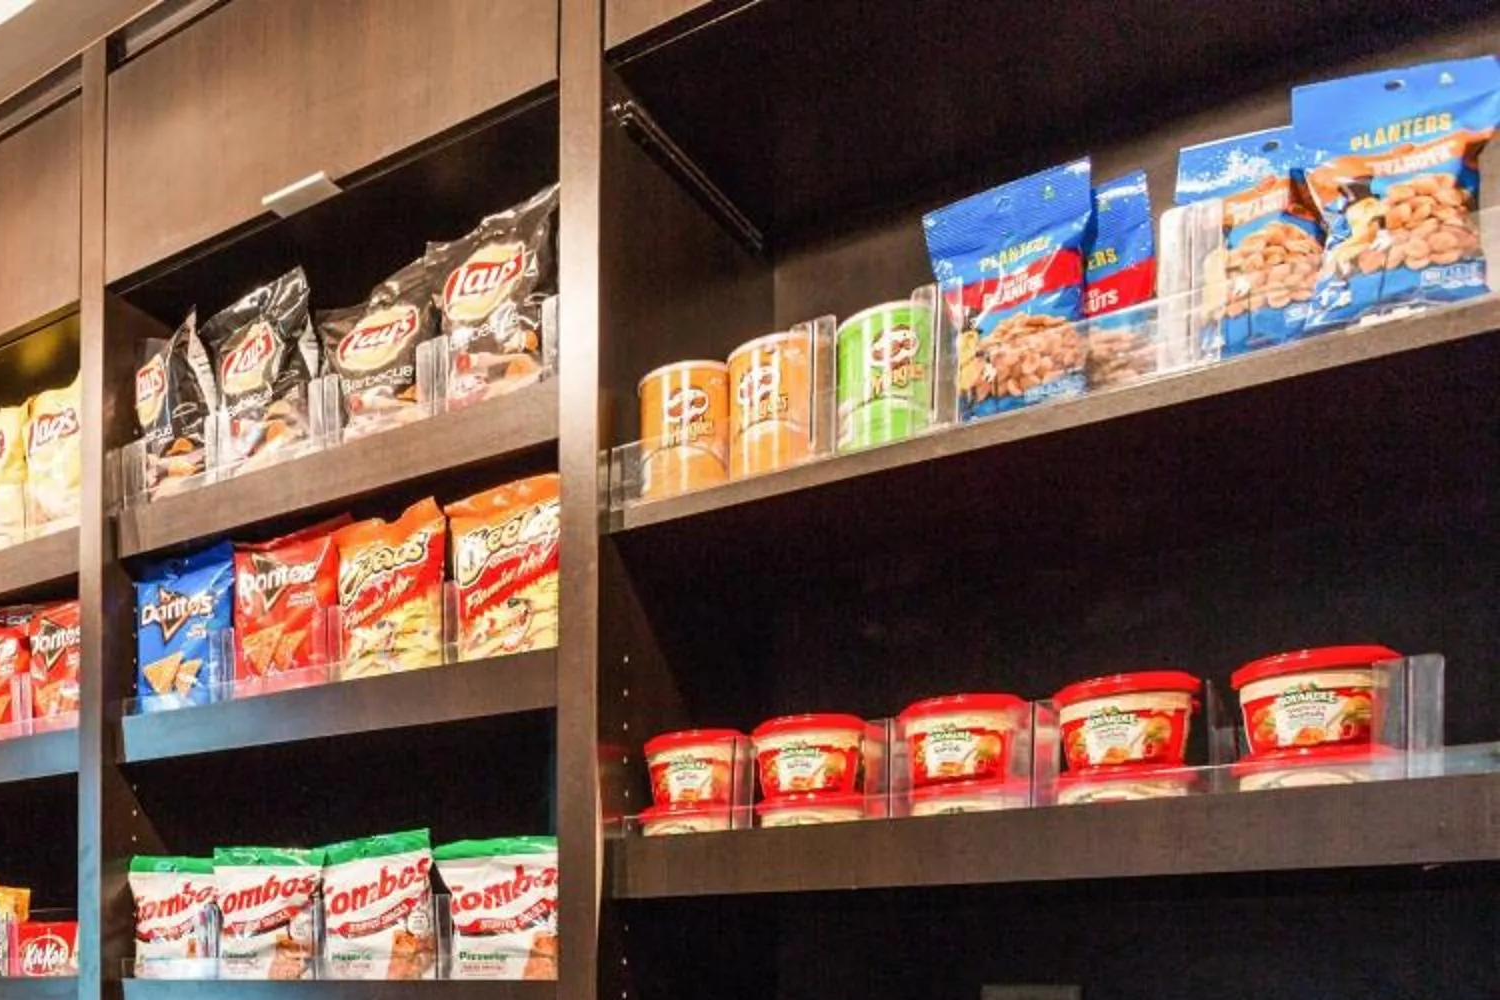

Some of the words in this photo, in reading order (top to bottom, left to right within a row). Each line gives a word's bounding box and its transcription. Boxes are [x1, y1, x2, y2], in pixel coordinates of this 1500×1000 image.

[1350, 112, 1453, 151] PLANTERS
[238, 562, 317, 593] Doritos
[142, 594, 214, 626] Doritos
[134, 881, 219, 924] ombo
[221, 874, 318, 915] ombos
[451, 864, 558, 915] ombo
